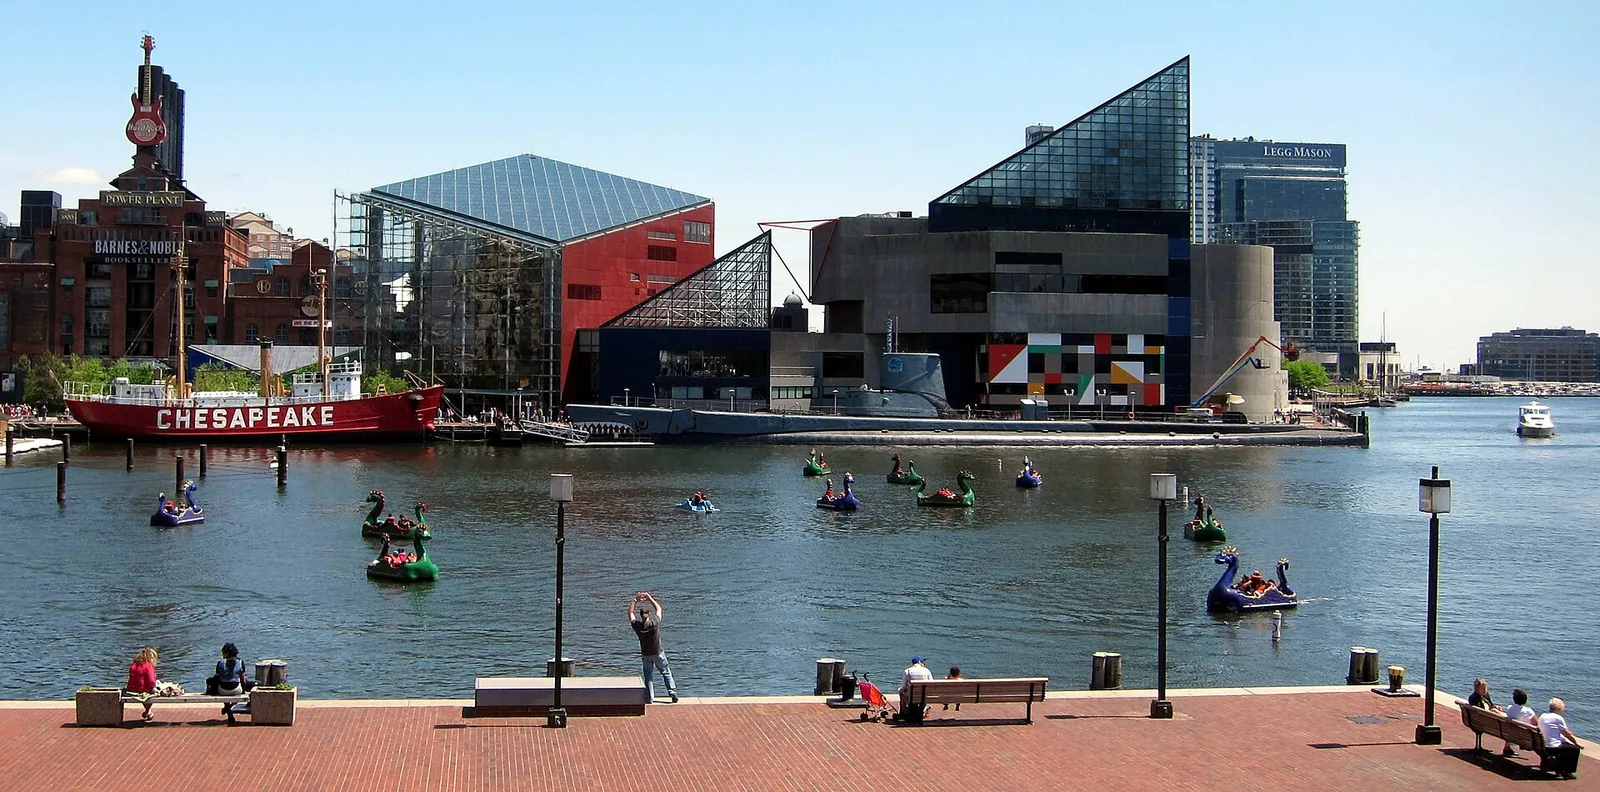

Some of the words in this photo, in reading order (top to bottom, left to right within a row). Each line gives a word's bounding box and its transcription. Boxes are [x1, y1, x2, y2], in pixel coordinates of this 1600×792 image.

[1264, 145, 1292, 157] LEGG
[1294, 147, 1332, 158] MASON
[106, 194, 142, 205] POWER
[146, 194, 180, 205] PLANT
[95, 240, 138, 255] BARNES
[105, 256, 173, 264] BOOKSELLER
[156, 406, 334, 430] CHESAPEAKE
